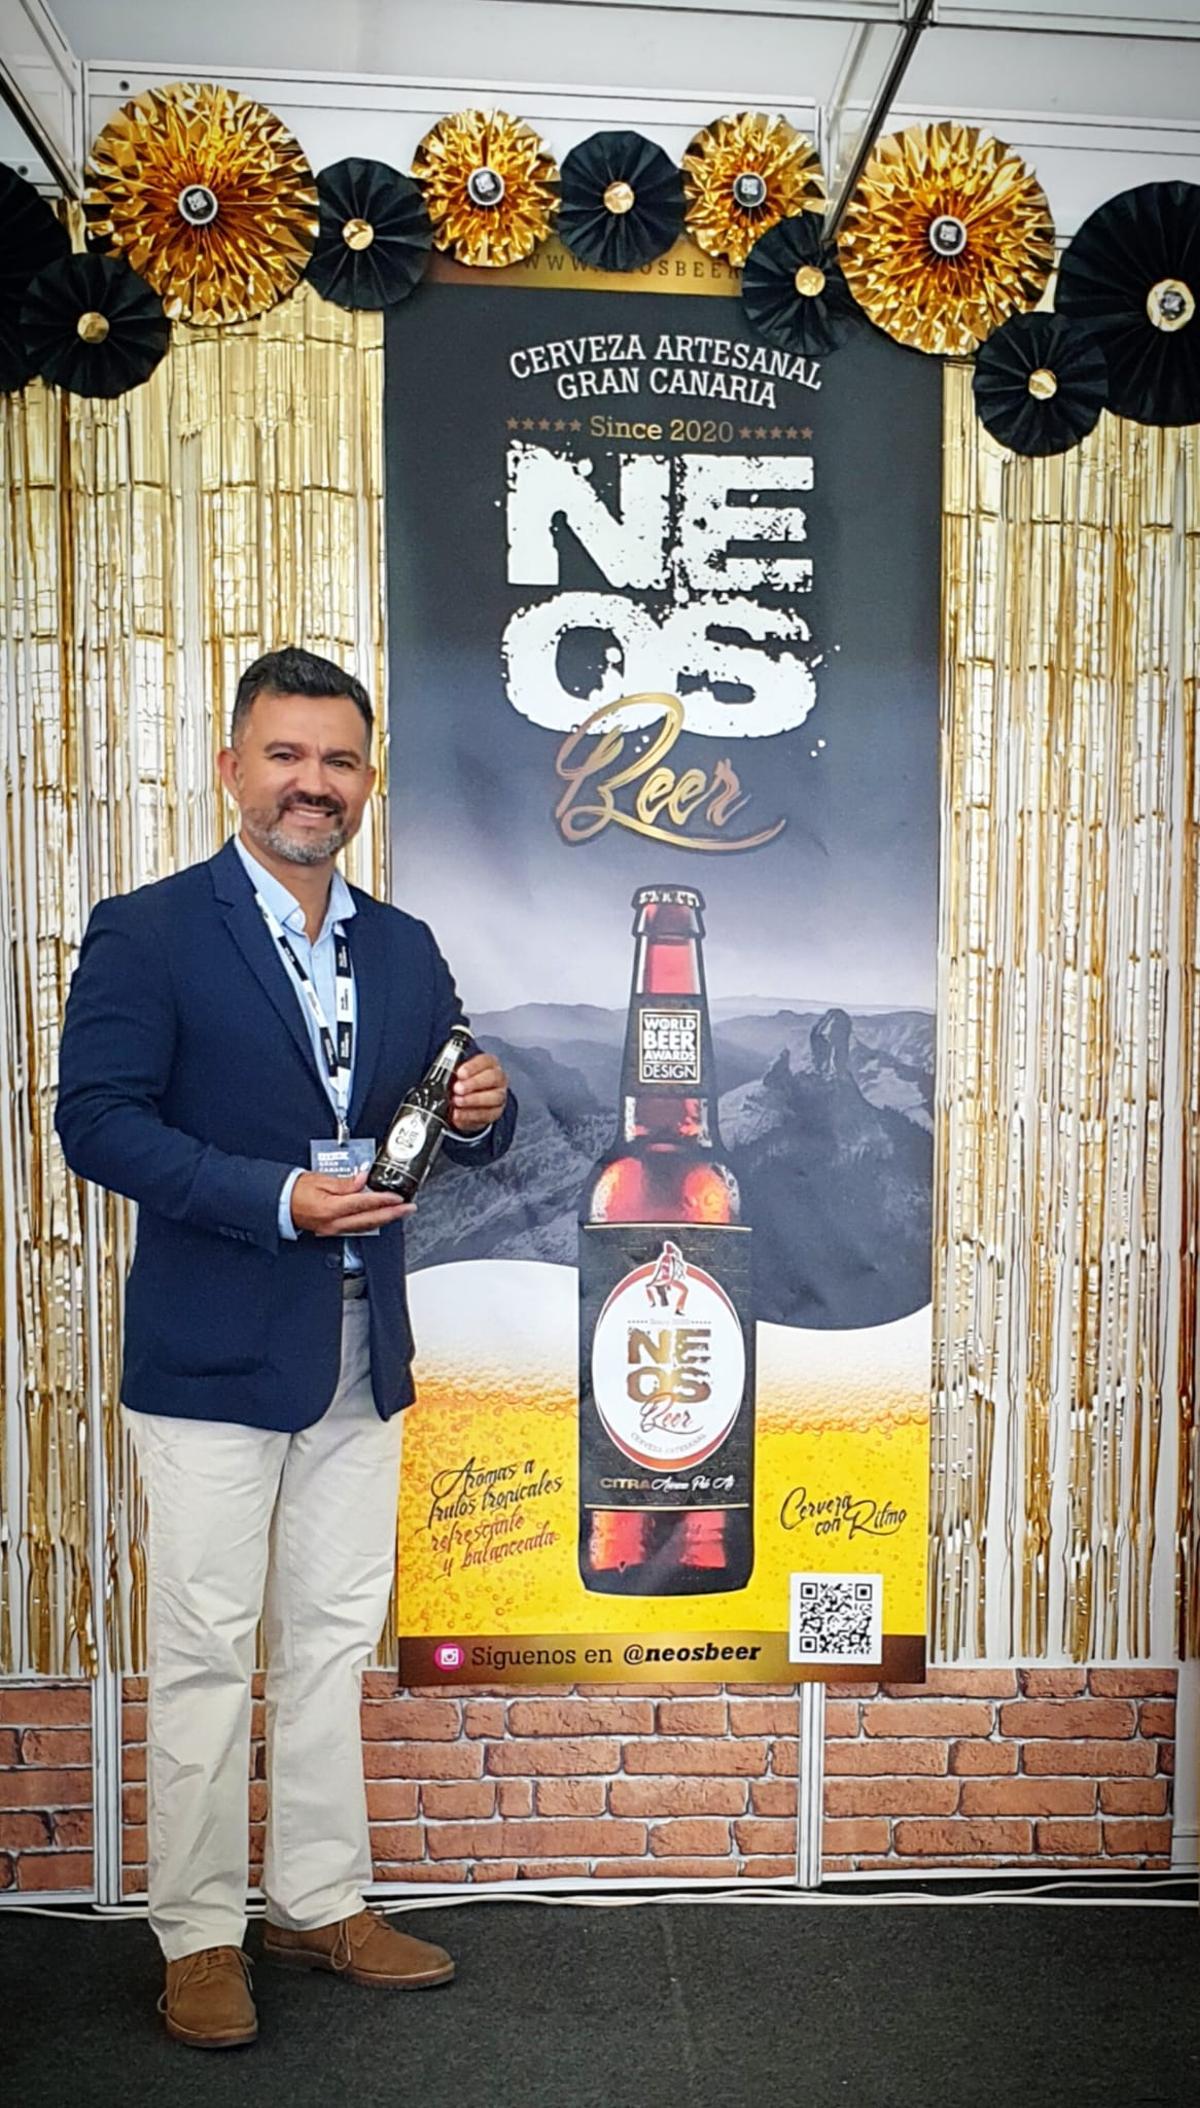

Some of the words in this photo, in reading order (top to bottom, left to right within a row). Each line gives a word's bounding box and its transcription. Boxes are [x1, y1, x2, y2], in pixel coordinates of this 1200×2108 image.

[509, 334, 647, 379] CERVEZA
[654, 334, 824, 391] ARTESANAL
[556, 367, 640, 401] GRAN
[649, 369, 777, 409] CANARIA
[589, 415, 662, 441] Since
[670, 418, 734, 443] 2020
[555, 692, 787, 852] Beer
[643, 1018, 697, 1031] WORLD
[643, 1031, 696, 1050] BEER
[643, 1051, 697, 1062] AWARDS
[643, 1064, 697, 1079] DESIGN
[639, 1392, 704, 1435] Beer
[431, 1456, 518, 1500] Aromas
[524, 1459, 536, 1475] a
[600, 1477, 651, 1490] CITRA
[415, 1493, 477, 1536] frutos
[481, 1468, 564, 1515] tropicales
[780, 1486, 852, 1531] Cerveza
[815, 1517, 842, 1537] con
[843, 1499, 908, 1541] Ritmo
[434, 1557, 454, 1583] y
[471, 1646, 576, 1670] Síguenos
[584, 1649, 613, 1664] en
[623, 1643, 762, 1666] @neosbeer
